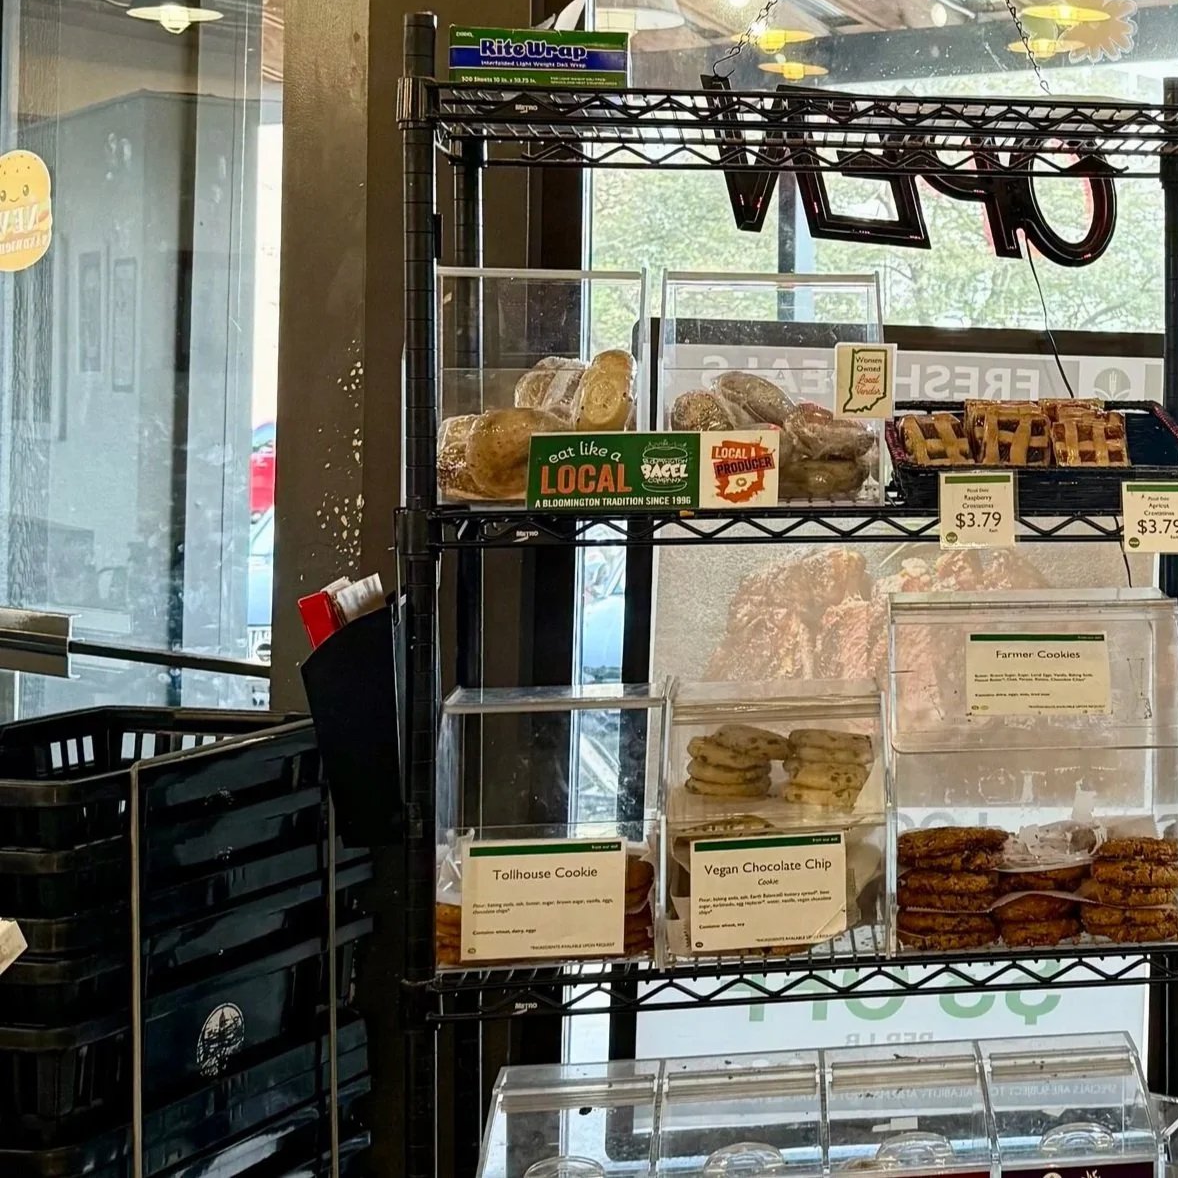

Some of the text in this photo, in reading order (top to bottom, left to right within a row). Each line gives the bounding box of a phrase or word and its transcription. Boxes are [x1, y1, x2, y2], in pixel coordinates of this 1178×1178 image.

[516, 60, 532, 68] Light
[514, 104, 538, 113] METRO
[856, 383, 882, 395] Vendor
[549, 440, 622, 464] eat like a
[715, 447, 748, 459] LOCAL
[716, 456, 772, 475] PRODUCER
[541, 463, 632, 495] LOCAL
[535, 499, 541, 508] A
[542, 498, 600, 508] BLOOMINGTON
[602, 497, 644, 507] TRADITION
[646, 496, 669, 506] SINCE
[955, 511, 1002, 529] $3.79
[995, 650, 1081, 659] Farmer Cookies
[492, 866, 598, 881] Tollhouse Cookie
[704, 858, 832, 877] Vegan Chocolate Chip
[757, 878, 779, 886] Cookie
